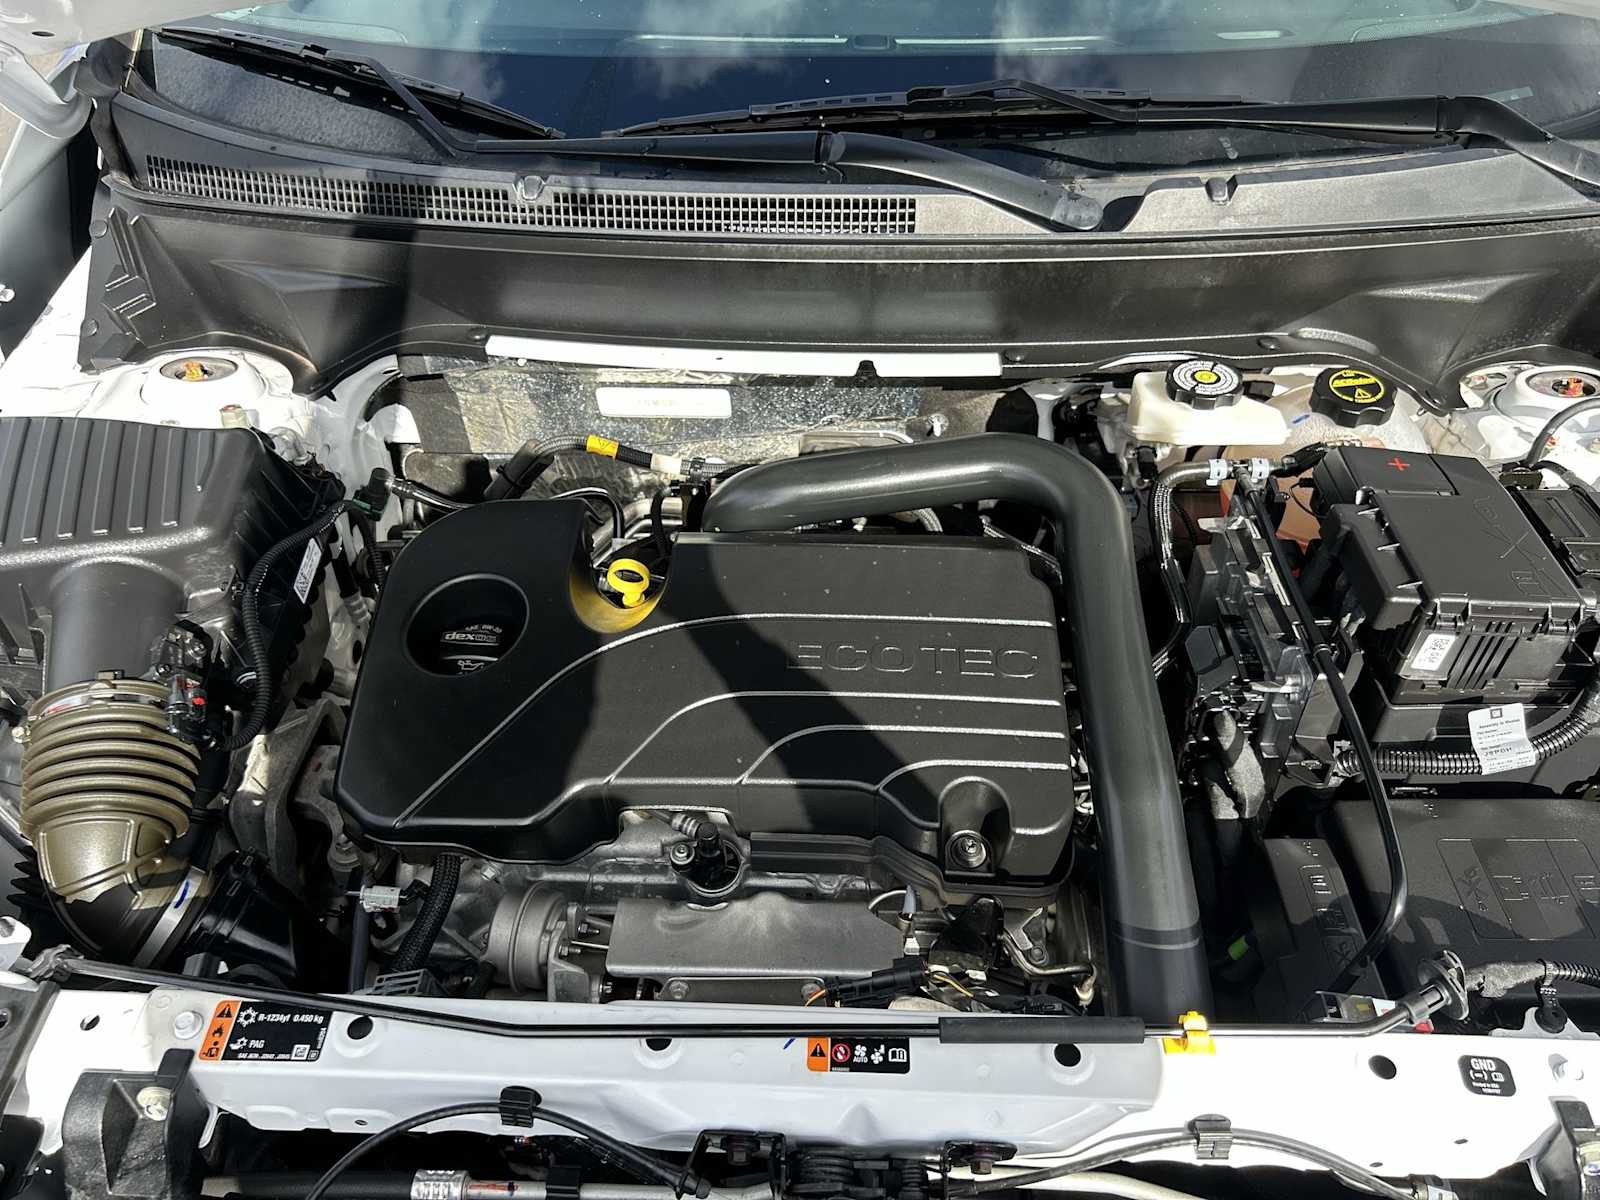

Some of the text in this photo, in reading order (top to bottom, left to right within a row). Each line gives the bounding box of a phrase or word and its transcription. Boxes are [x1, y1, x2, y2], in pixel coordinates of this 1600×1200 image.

[787, 645, 1039, 679] ECOTEC
[258, 1013, 324, 1025] R-1234yf 0.450 kg
[248, 1039, 265, 1049] PAG
[1470, 1058, 1496, 1071] GND
